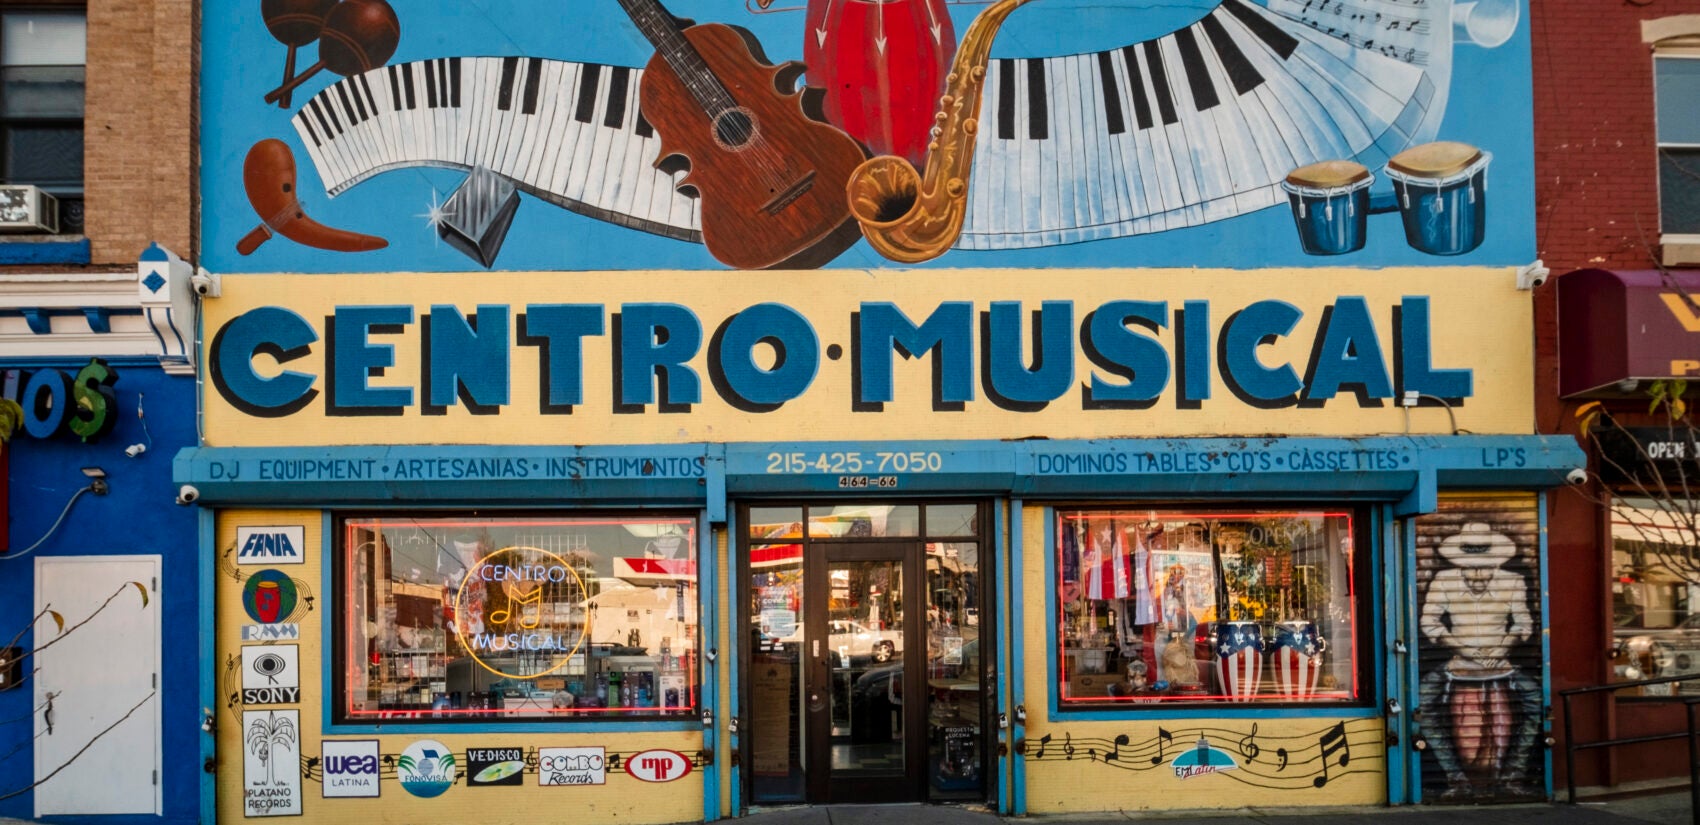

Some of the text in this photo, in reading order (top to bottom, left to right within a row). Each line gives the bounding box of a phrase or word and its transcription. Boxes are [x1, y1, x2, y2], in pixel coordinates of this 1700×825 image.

[209, 295, 1474, 417] CENTRO MUSICAL
[1481, 448, 1526, 468] LP'S
[1648, 441, 1684, 458] OPEN
[210, 457, 705, 480] DJ EQUIPMENT ARTESANIAS INSTRUMENTOS
[766, 452, 942, 474] 215-425-7050
[1038, 452, 1127, 474] DOMINOS
[1132, 451, 1212, 473] TABLES
[1288, 449, 1399, 471] CASSETTES
[839, 476, 897, 488] 464-66
[239, 533, 297, 557] FANIA
[481, 563, 566, 583] CENTRO
[472, 633, 568, 651] MUSICAL
[244, 688, 299, 704] SONY
[325, 755, 377, 775] wea
[540, 754, 604, 772] COMBO
[331, 778, 370, 787] LATINA
[404, 774, 448, 783] FONOVISA
[548, 771, 594, 786] Records
[247, 787, 292, 798] PLATANO
[248, 798, 292, 809] RECORDS
